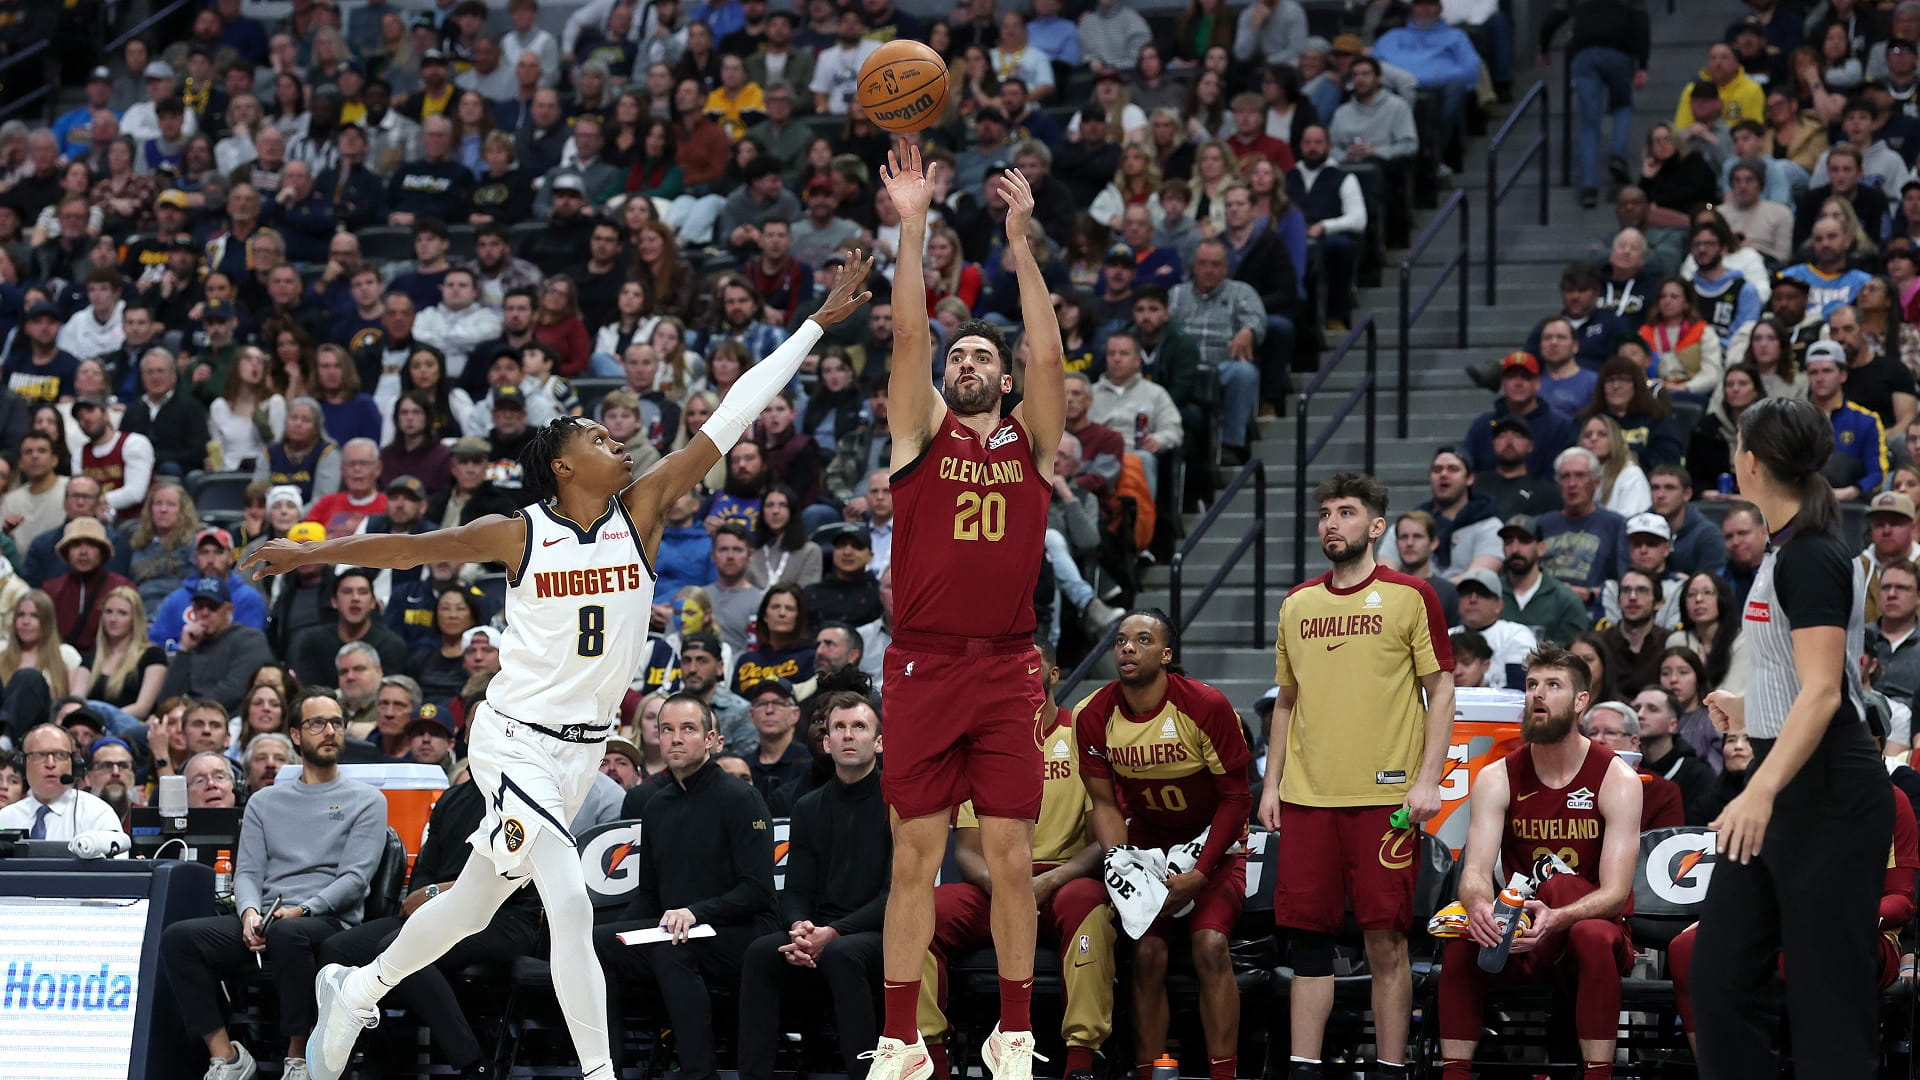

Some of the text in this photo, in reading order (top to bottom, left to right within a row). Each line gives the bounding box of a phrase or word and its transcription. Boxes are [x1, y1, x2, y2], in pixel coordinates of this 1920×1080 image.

[874, 93, 935, 120] Wilson
[940, 456, 1024, 486] CLEVLAND
[953, 491, 1006, 542] 20
[602, 530, 630, 541] ibotta
[533, 563, 641, 599] NUGGETS
[577, 605, 605, 657] 8
[1300, 614, 1383, 640] CAVALIERS
[1141, 784, 1188, 812] 10
[1567, 800, 1594, 809] CLIFFS
[1512, 818, 1599, 840] CLEVELAND
[3, 960, 132, 1012] Honda
